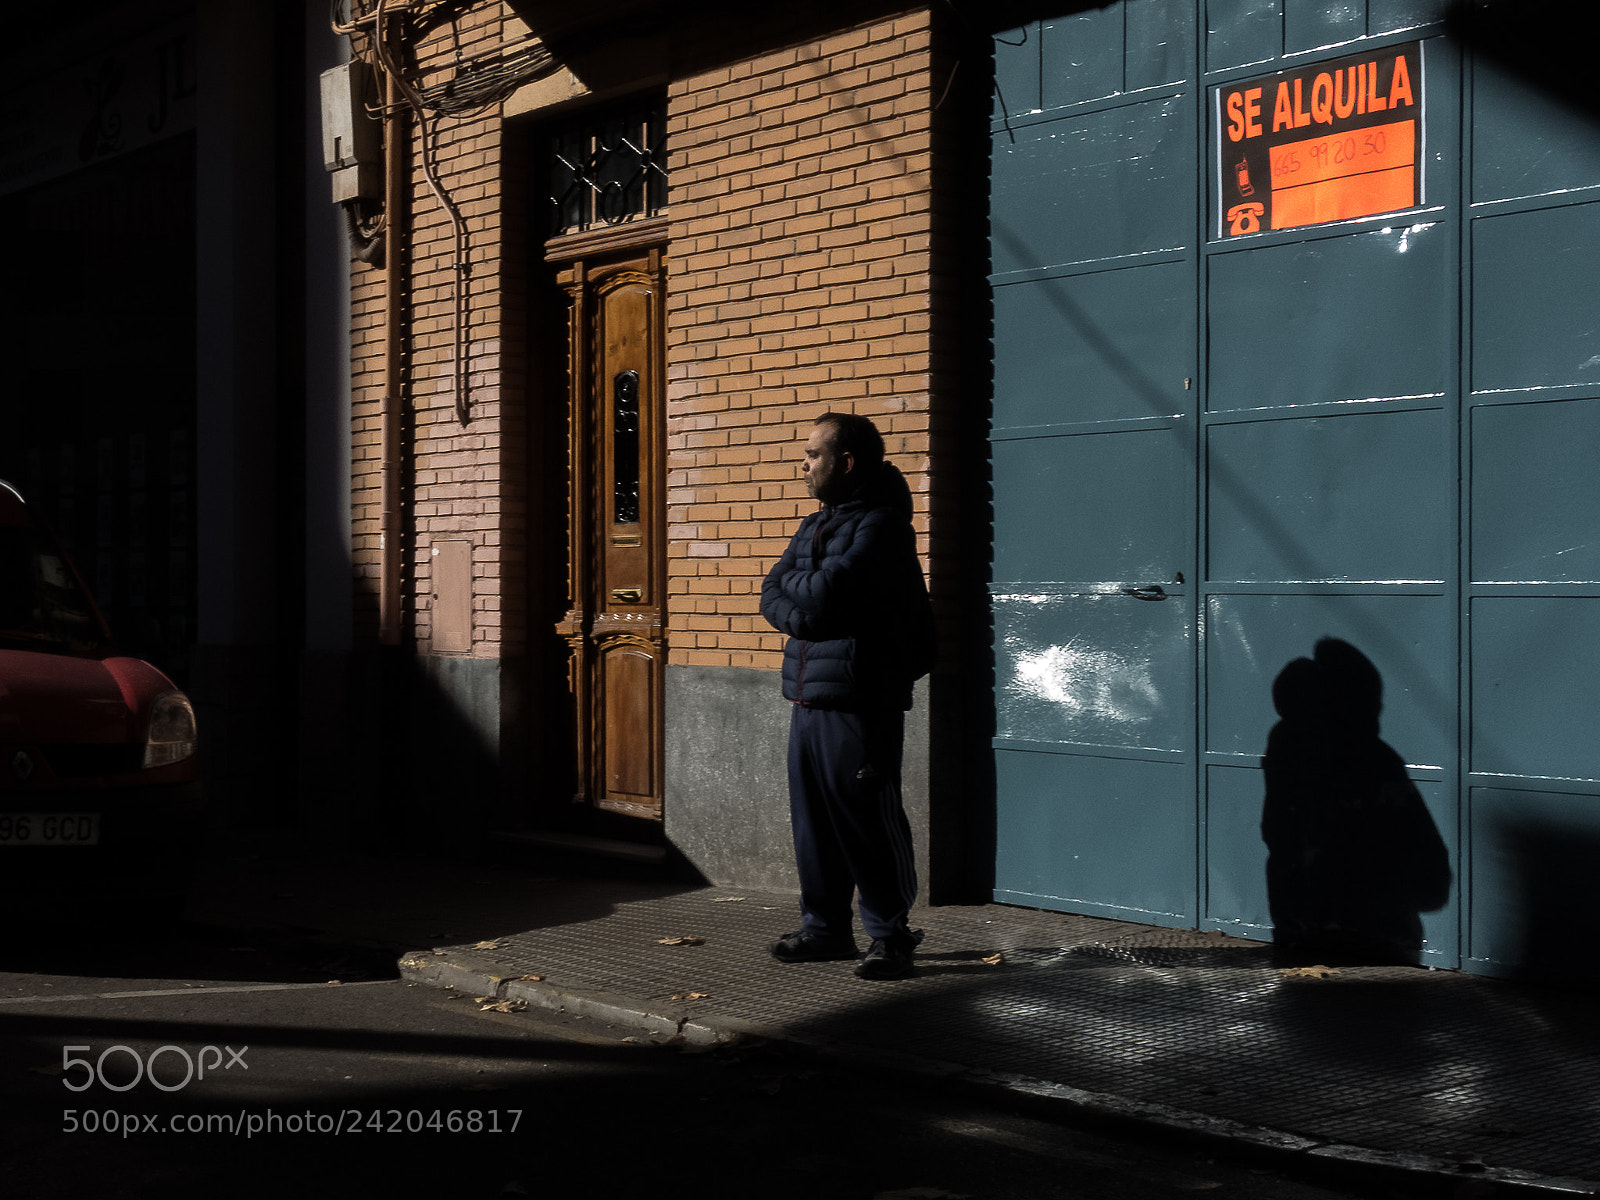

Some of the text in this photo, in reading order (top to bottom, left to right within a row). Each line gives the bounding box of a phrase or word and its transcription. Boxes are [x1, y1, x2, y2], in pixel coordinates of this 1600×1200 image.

[1227, 55, 1414, 142] SE ALQUILA
[1363, 131, 1386, 156] 30
[43, 816, 92, 841] GCD
